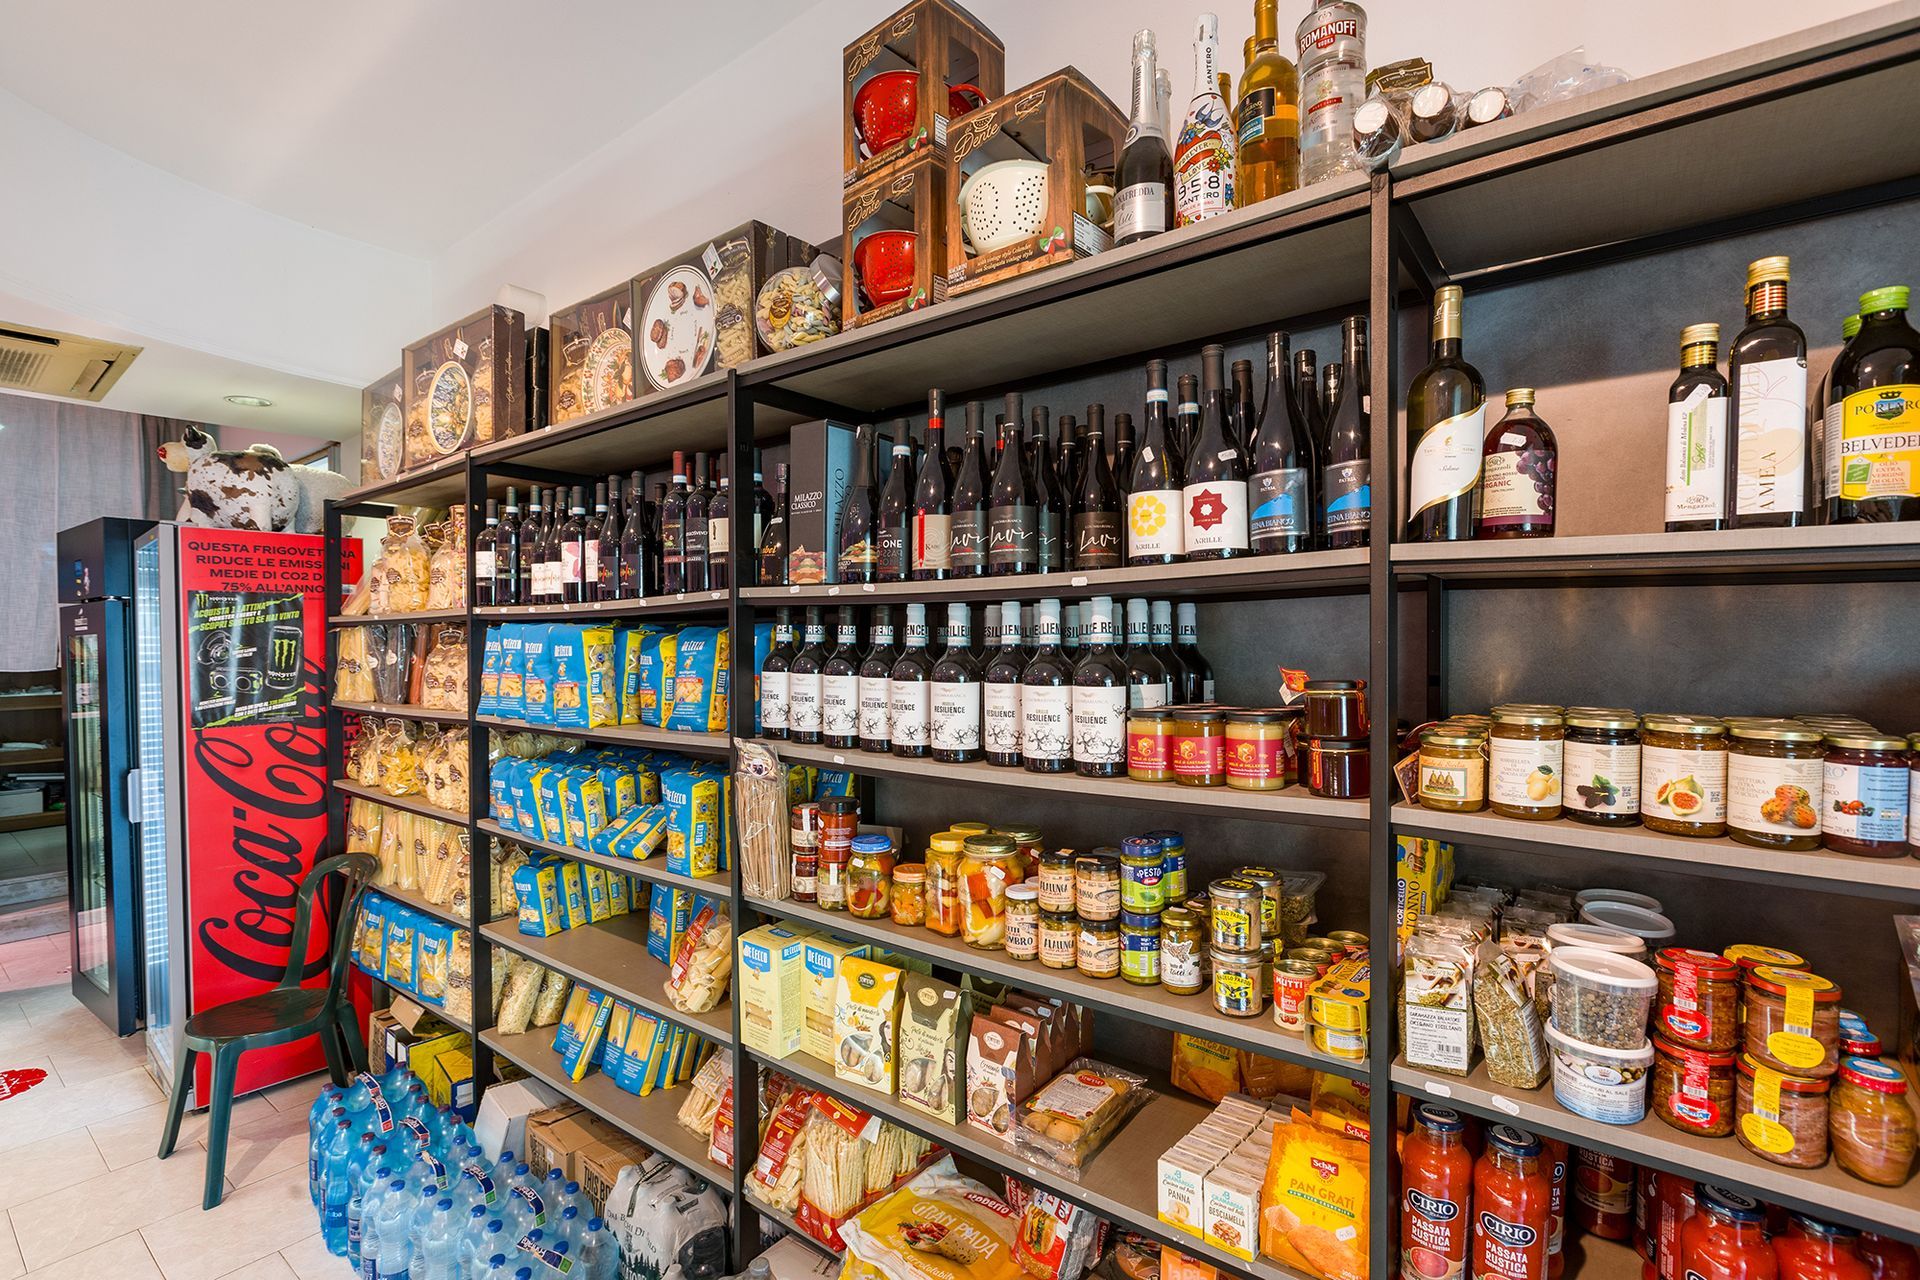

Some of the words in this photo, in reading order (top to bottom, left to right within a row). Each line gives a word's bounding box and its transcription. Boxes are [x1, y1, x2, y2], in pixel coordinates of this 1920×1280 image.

[1300, 19, 1356, 53] ROMANOFF
[1318, 37, 1334, 48] VODKA
[1178, 142, 1208, 167] FOREVER
[1188, 162, 1207, 178] LOVE
[1758, 450, 1776, 512] AMEA
[794, 490, 822, 502] MILAZZO
[790, 500, 816, 511] CLASSICO
[1265, 518, 1294, 527] BIANCO
[1328, 514, 1344, 524] ETNA
[188, 542, 250, 553] QUESTA
[253, 545, 356, 559] FRIGOVETNA
[196, 555, 253, 566] RIDUCE
[258, 558, 275, 567] LE
[279, 559, 350, 570] EMISSNI
[210, 569, 258, 578] MEDIE
[262, 570, 277, 580] DI
[280, 571, 309, 580] CO2
[222, 582, 252, 592] 75%
[194, 607, 230, 618] ACQUISTA
[200, 621, 227, 631] SCOPRI
[228, 617, 255, 628] SUBITO
[256, 616, 264, 624] SE
[266, 614, 278, 622] HAI
[279, 611, 300, 621] VINTO
[934, 705, 966, 714] RESILIENCE
[986, 709, 1016, 718] RESILIENCE
[1026, 714, 1061, 722] RESILIENCE
[1074, 715, 1108, 724] RESILIENCE
[1138, 868, 1162, 878] PESTO
[1397, 880, 1406, 924] PORTICELLO
[1406, 880, 1420, 930] TONNO
[744, 945, 751, 957] DE
[751, 946, 768, 964] CECCO
[807, 949, 815, 962] DE
[815, 953, 832, 969] CECCO
[1276, 977, 1303, 989] MUTTI
[1410, 1021, 1433, 1029] ORIGANO
[1435, 1024, 1462, 1032] SICILIANO
[1188, 1036, 1205, 1046] PAN
[584, 1165, 600, 1194] THIS
[1164, 1174, 1195, 1189] GRANAROLO
[1290, 1178, 1316, 1194] PAN
[1168, 1189, 1191, 1205] PANNA
[1211, 1194, 1244, 1210] GRANAROLO
[1410, 1192, 1454, 1216] CIRIO
[1208, 1207, 1246, 1228] BESCIAMELLA
[911, 1201, 956, 1228] GRAN
[955, 1222, 1000, 1260] PIADA
[1412, 1215, 1450, 1237] PASSATA
[1484, 1215, 1531, 1241] CIRIO
[1412, 1225, 1450, 1247] RUSTICA
[1486, 1240, 1528, 1264] PASSATA
[1486, 1250, 1527, 1273] RUSTICA
